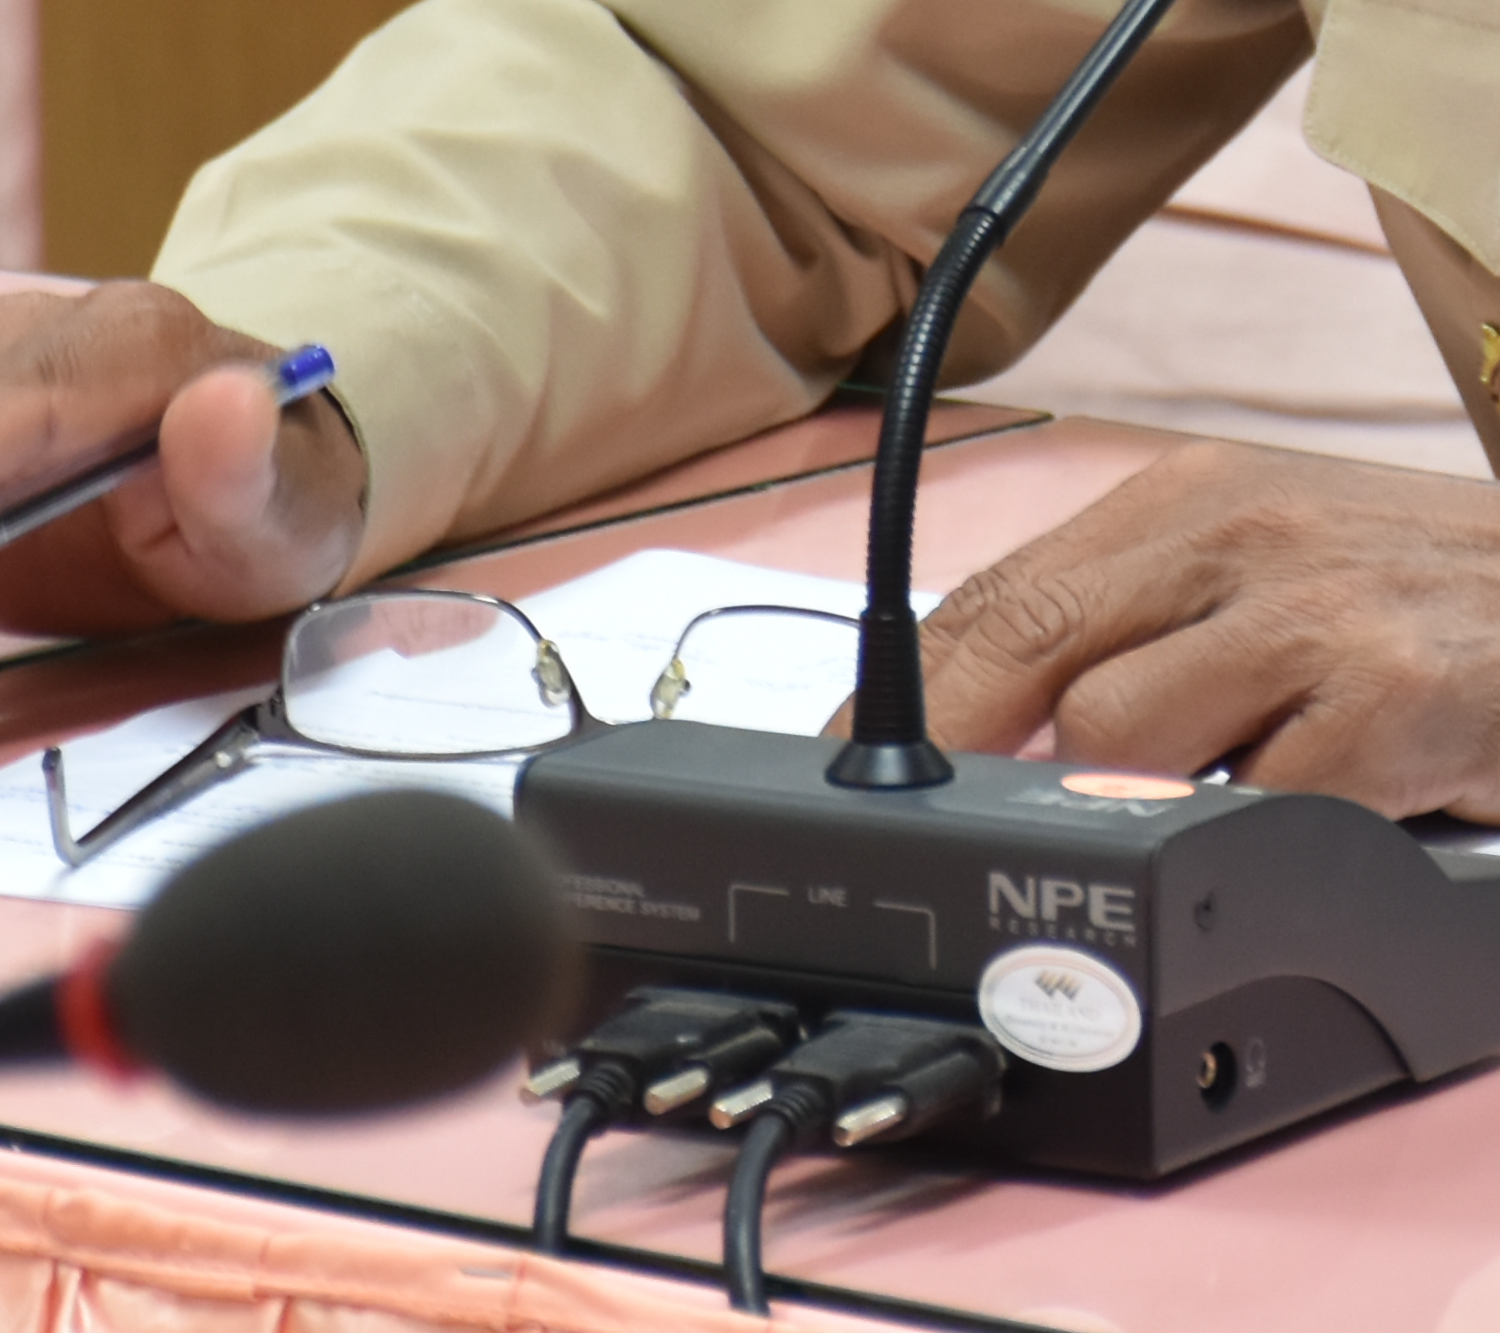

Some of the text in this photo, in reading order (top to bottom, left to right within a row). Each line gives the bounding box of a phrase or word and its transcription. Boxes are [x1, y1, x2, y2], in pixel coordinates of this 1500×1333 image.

[807, 884, 848, 908] LINE
[988, 870, 1136, 933] NPE
[988, 915, 1138, 948] RESEARCH
